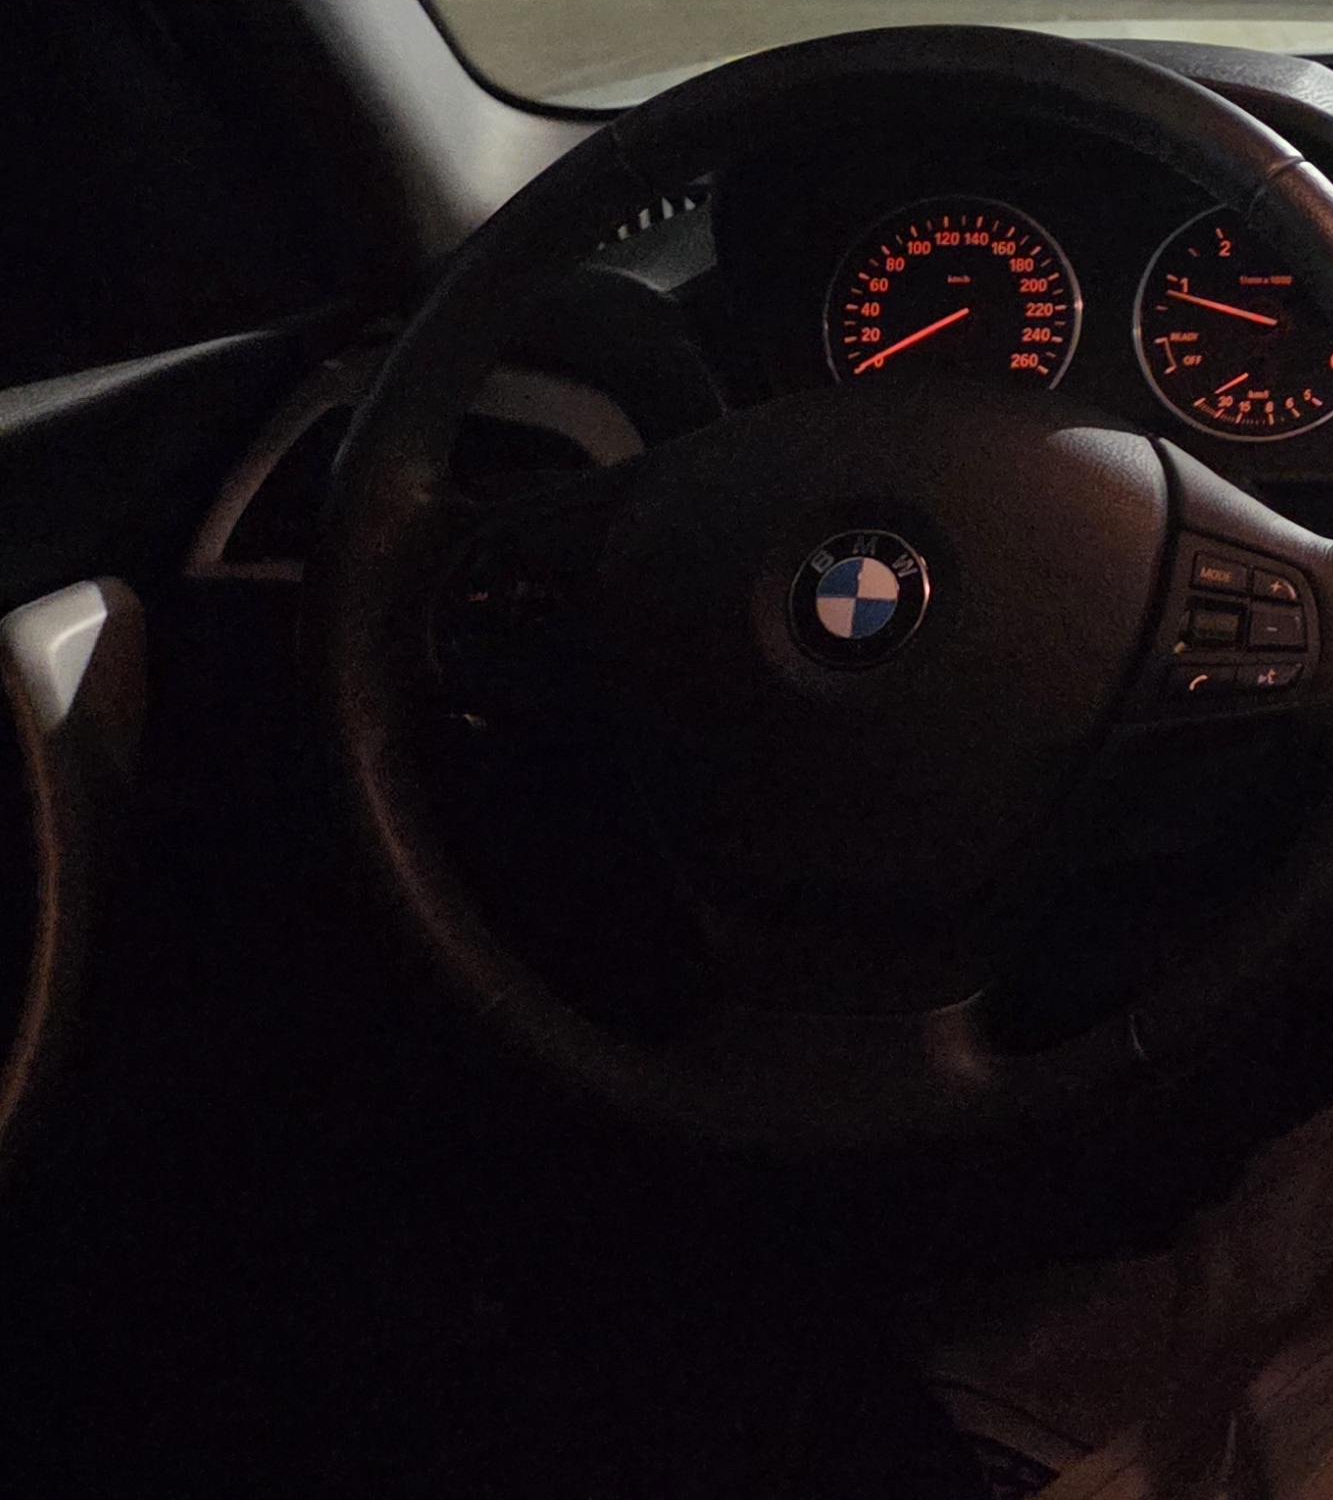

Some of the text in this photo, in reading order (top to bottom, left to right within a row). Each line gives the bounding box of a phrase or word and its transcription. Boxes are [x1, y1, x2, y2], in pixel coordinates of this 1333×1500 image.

[934, 231, 960, 246] 120
[964, 231, 989, 246] 140
[907, 241, 932, 255] 100
[991, 241, 1016, 255] 160
[1218, 240, 1231, 257] 2
[886, 257, 905, 271] 80
[1009, 258, 1034, 272] 180
[870, 278, 889, 292] 60
[1020, 278, 1047, 292] 200
[1180, 277, 1189, 293] 1
[861, 302, 880, 317] 40
[1026, 302, 1053, 317] 220
[861, 327, 881, 342] 20
[1022, 327, 1050, 342] 240
[1011, 353, 1039, 368] 260
[1182, 355, 1202, 366] OFF
[810, 535, 919, 578] BMW
[1200, 567, 1231, 583] MODE
